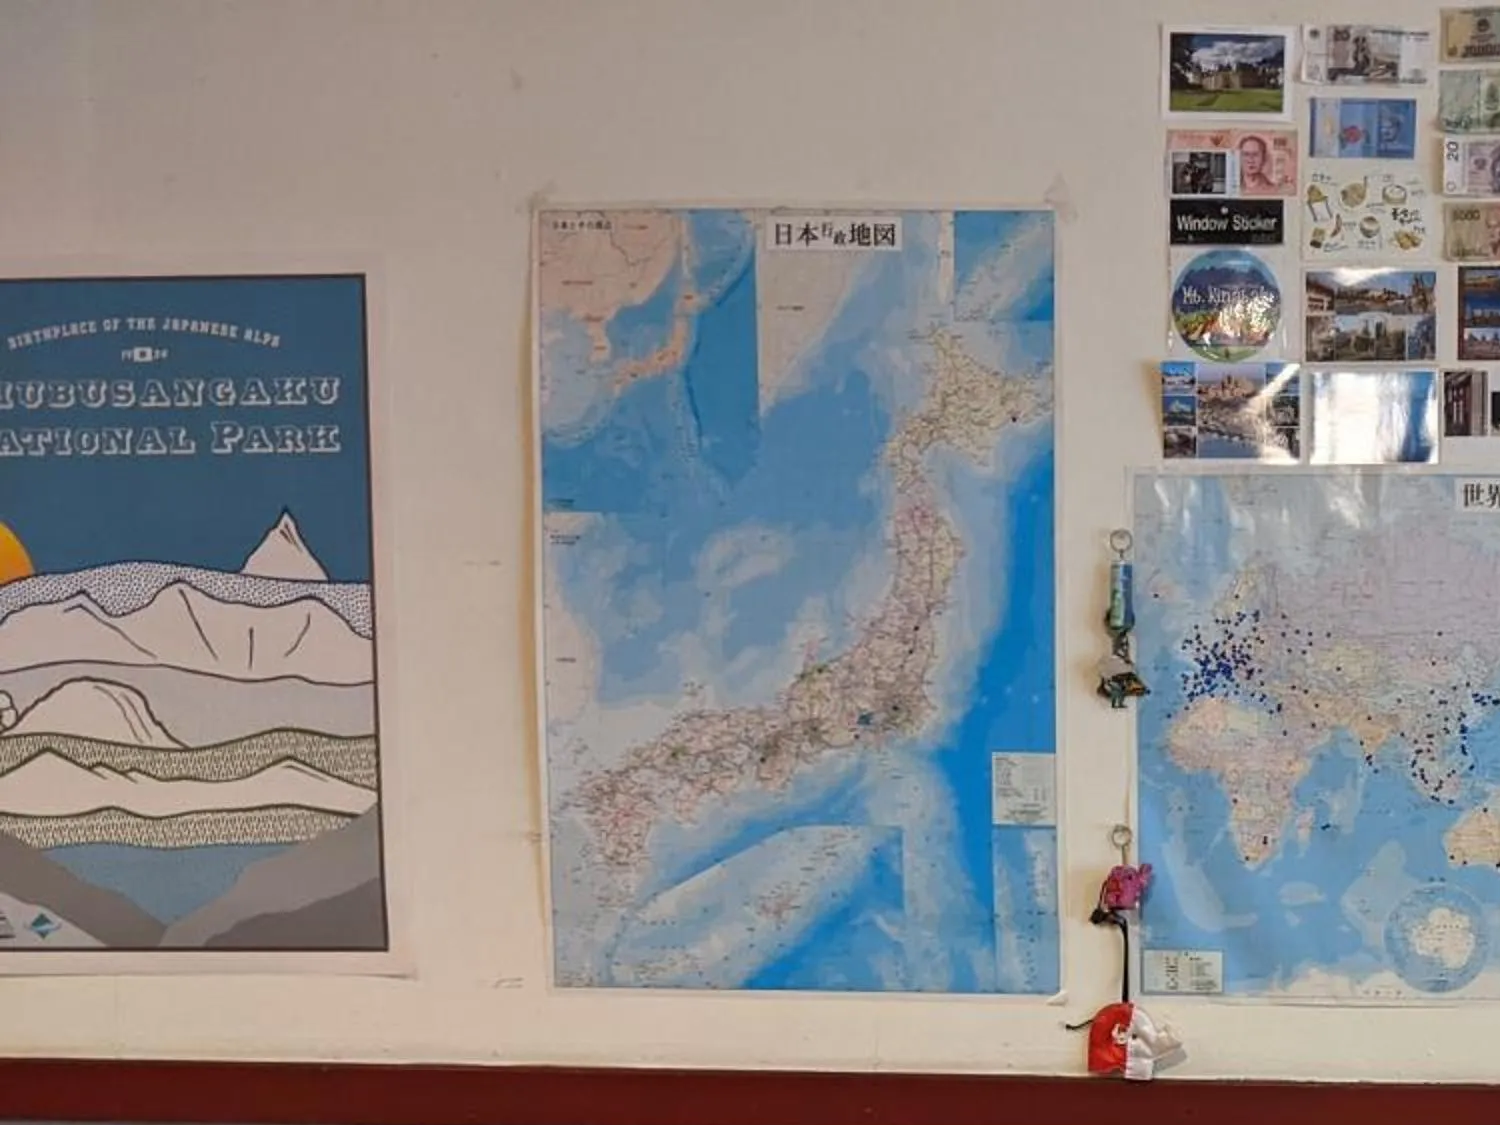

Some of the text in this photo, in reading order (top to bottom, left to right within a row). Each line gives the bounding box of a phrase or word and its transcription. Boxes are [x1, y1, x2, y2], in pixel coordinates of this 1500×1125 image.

[1446, 141, 1459, 161] 20
[774, 221, 896, 247] 日本行政地図
[1177, 215, 1229, 231] Window
[7, 318, 281, 350] BIRTHPLACE OF THE JAPANESE ALPS
[211, 421, 342, 453] PARK
